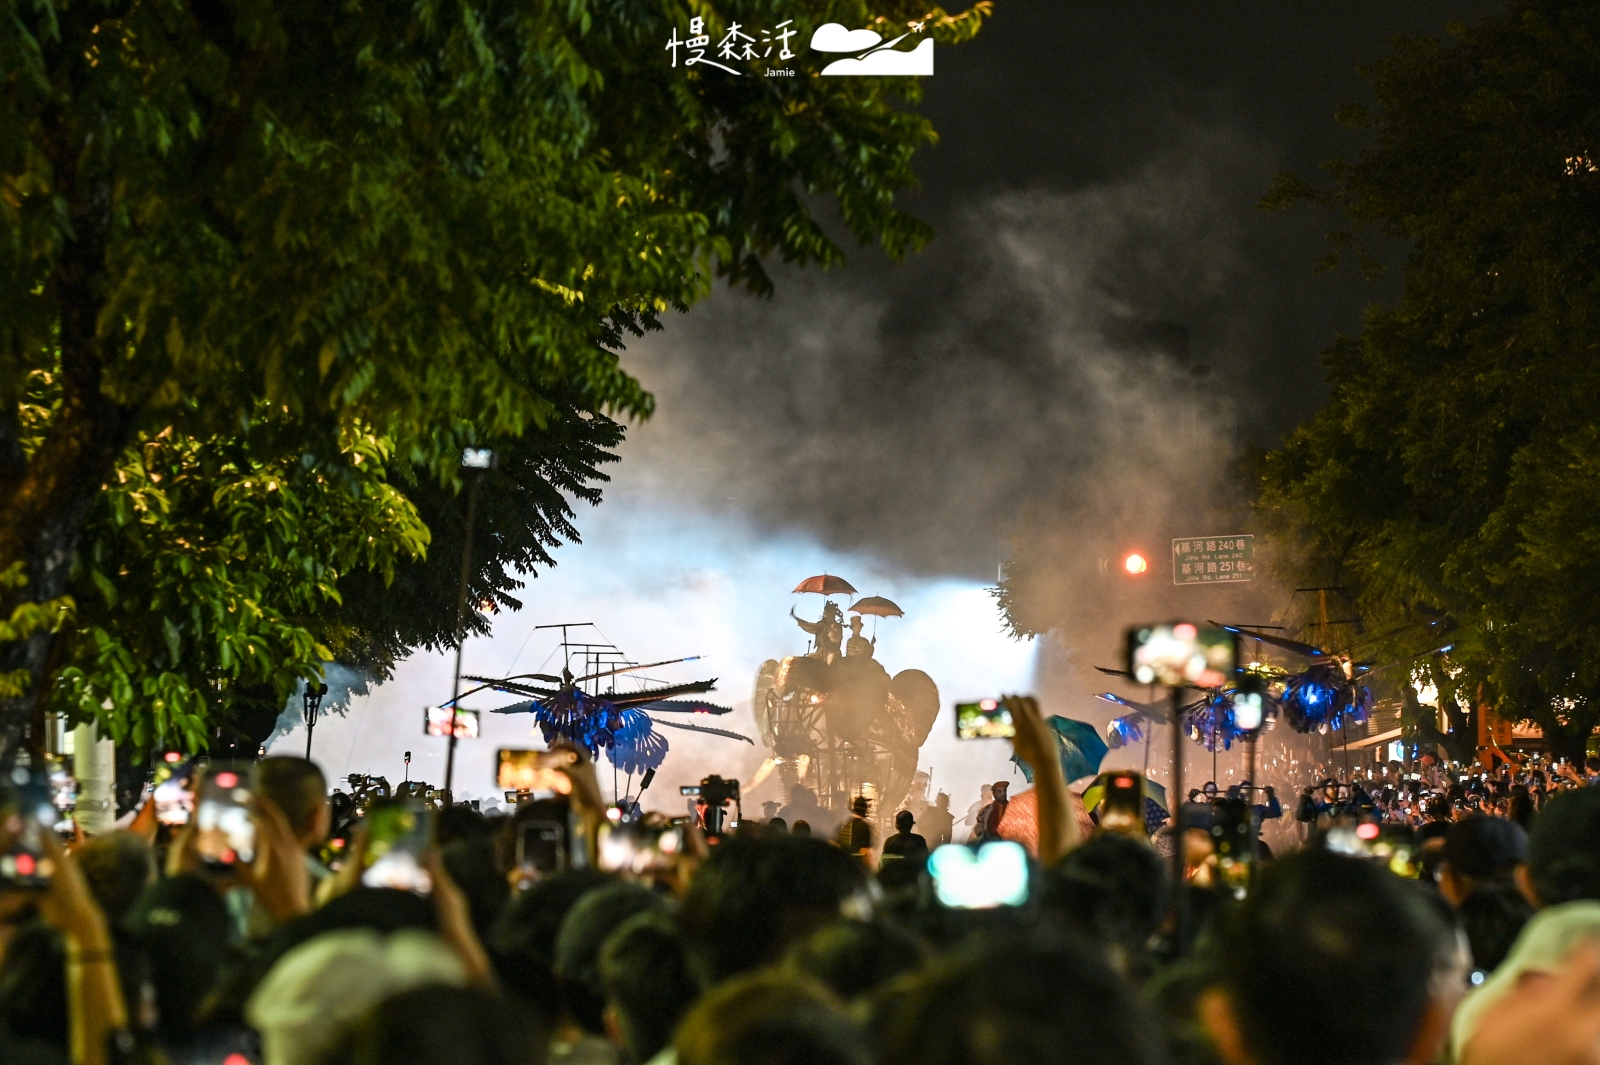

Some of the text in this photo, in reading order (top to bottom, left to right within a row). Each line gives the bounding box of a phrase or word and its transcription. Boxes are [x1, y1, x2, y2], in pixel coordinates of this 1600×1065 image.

[1181, 539, 1245, 553] 基河路240巷
[1182, 561, 1246, 574] 基河路251巷
